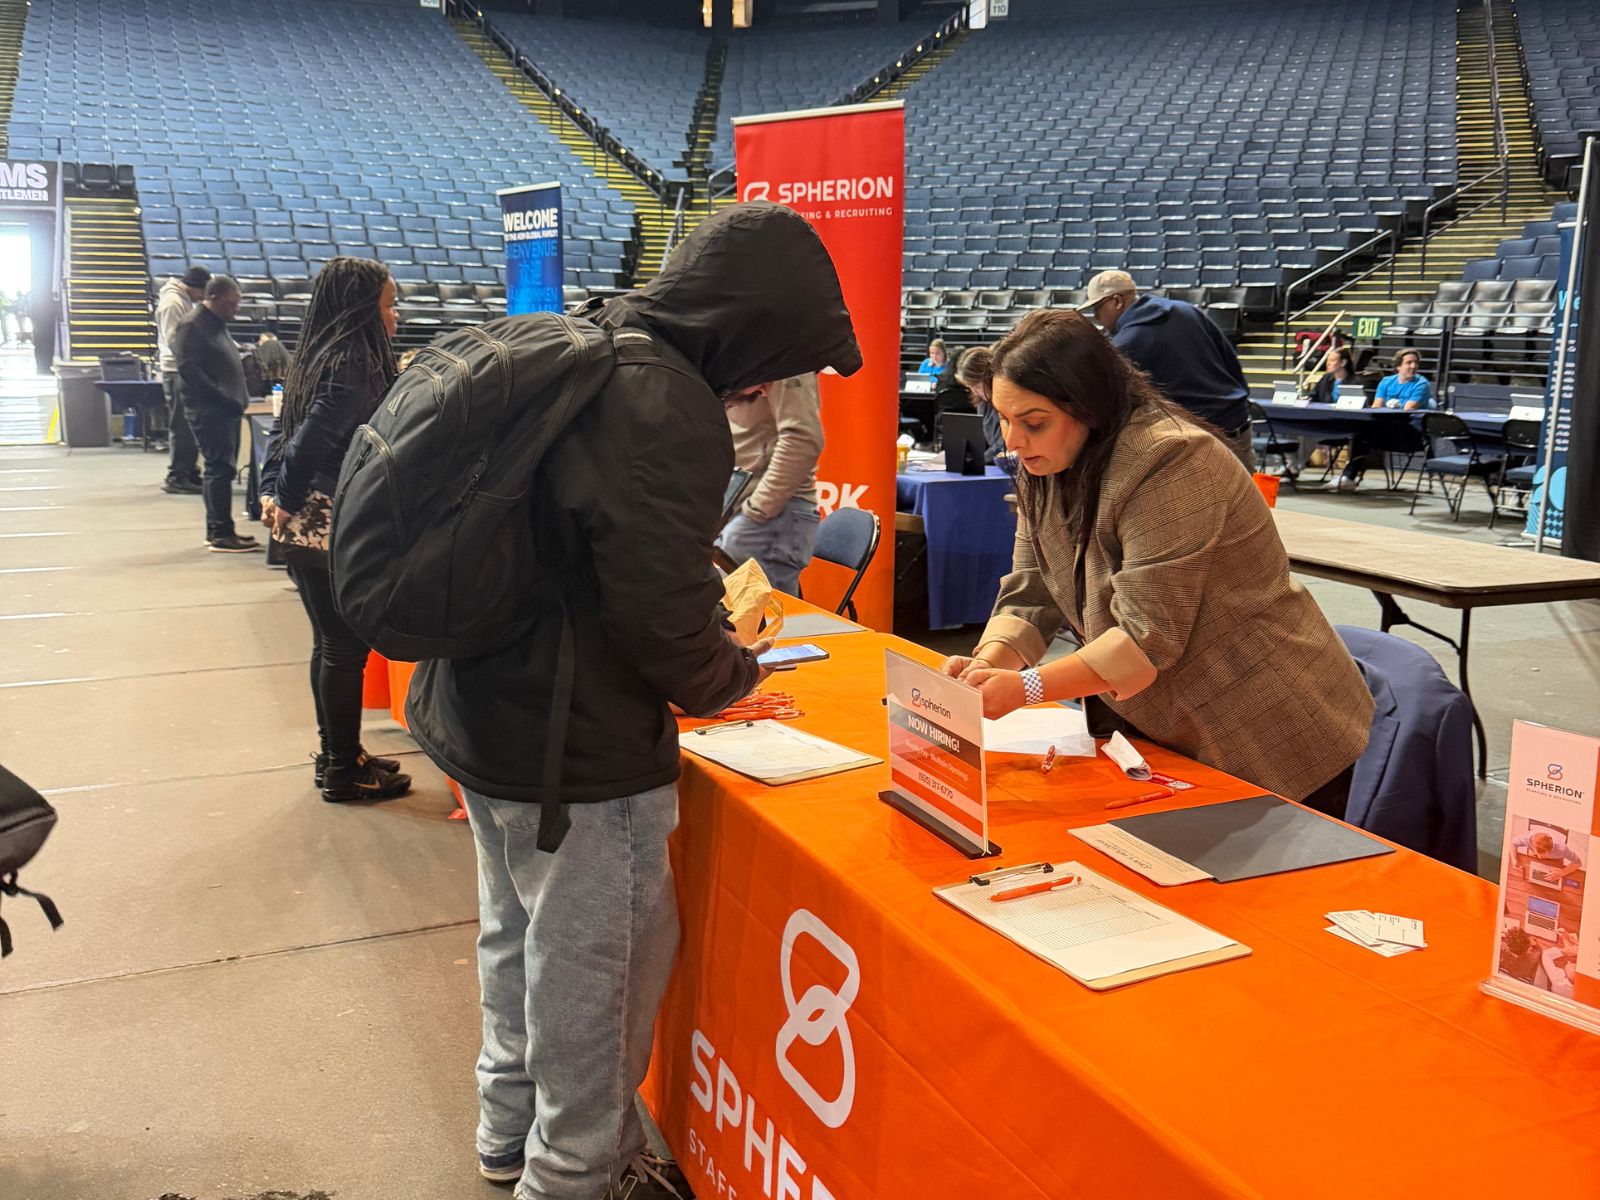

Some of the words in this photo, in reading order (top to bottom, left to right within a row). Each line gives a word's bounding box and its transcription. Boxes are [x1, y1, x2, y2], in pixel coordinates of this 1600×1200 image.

[778, 176, 893, 204] SPHERION
[503, 208, 558, 232] WELCOME
[825, 210, 832, 219] &
[834, 206, 893, 219] RECRUITING
[1357, 317, 1380, 337] EXIT
[921, 698, 951, 719] spherion
[908, 714, 928, 735] NOW
[929, 724, 960, 753] HIRING!
